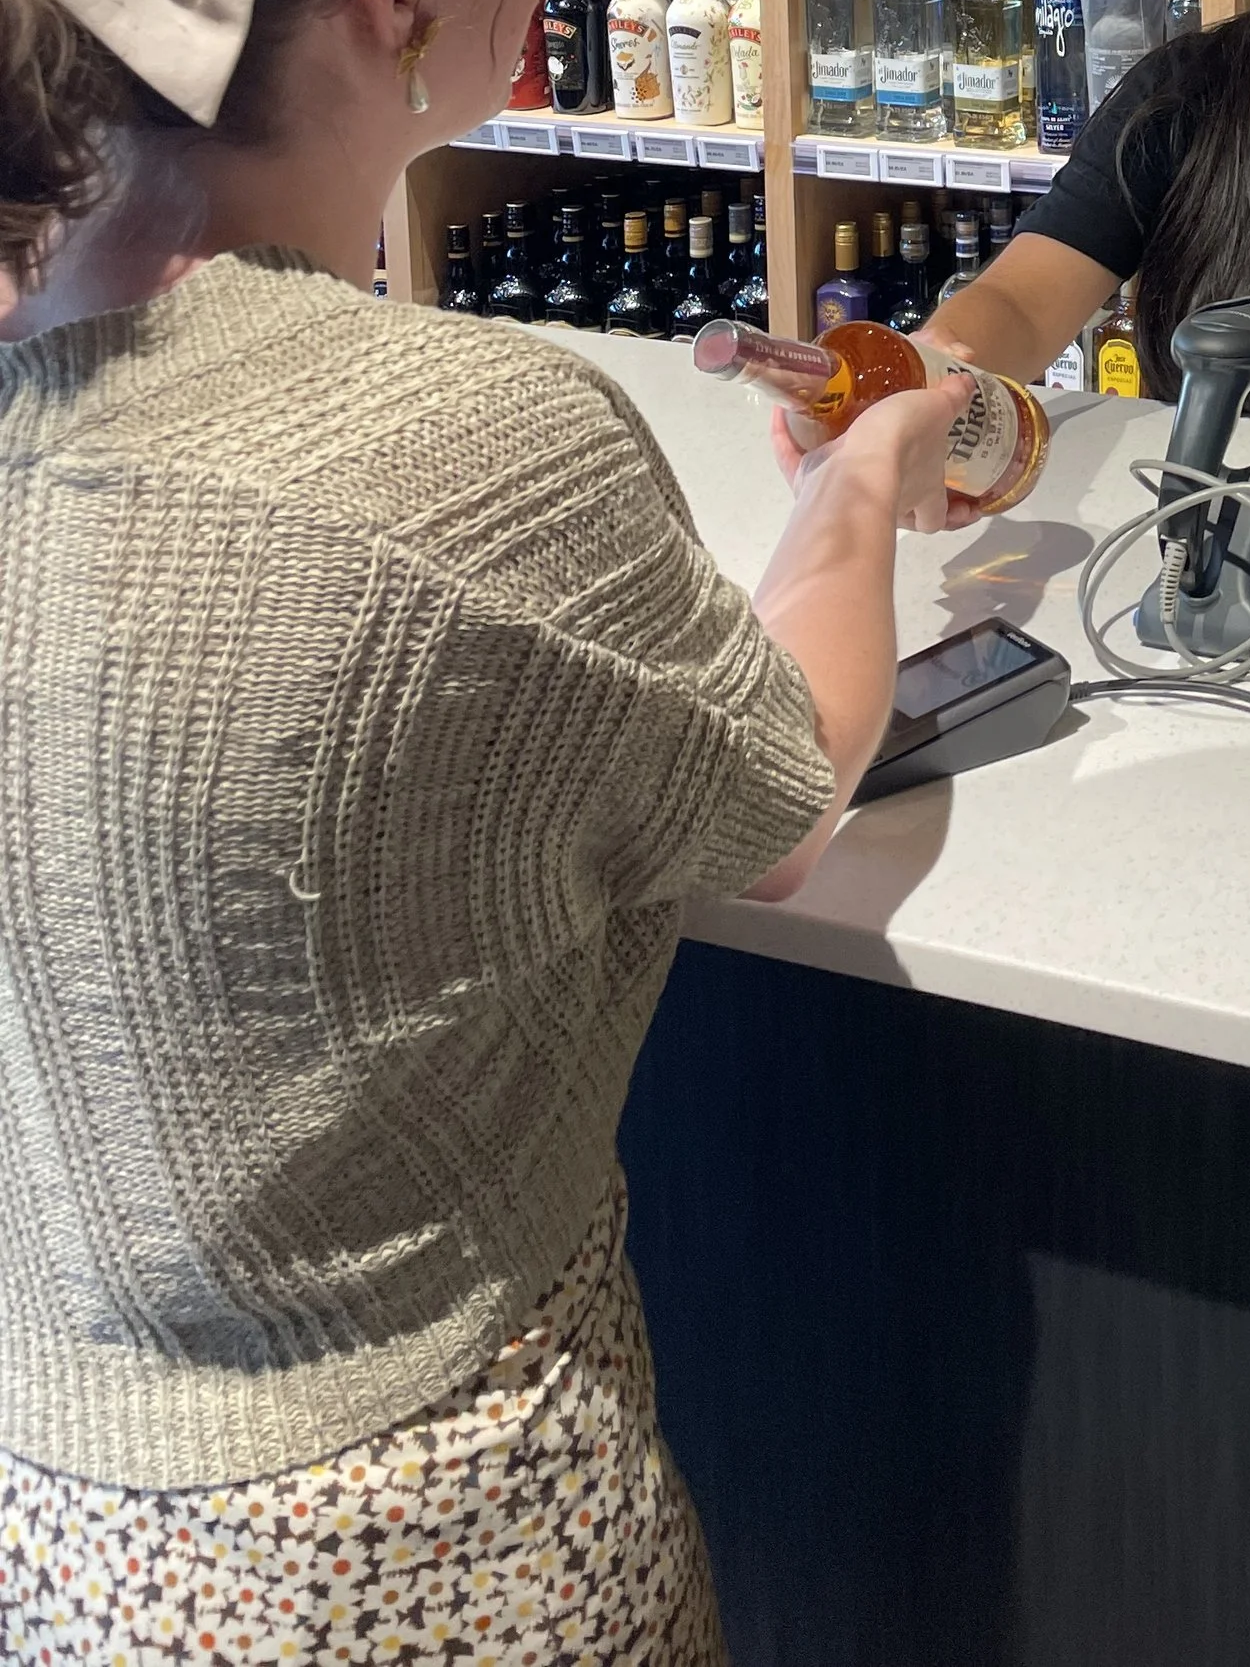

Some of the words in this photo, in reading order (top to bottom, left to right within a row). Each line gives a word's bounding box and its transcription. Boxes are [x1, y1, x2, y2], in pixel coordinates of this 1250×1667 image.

[543, 21, 574, 36] ILEYS
[812, 62, 850, 78] Jimador
[881, 63, 918, 83] Jimador
[960, 70, 997, 90] Jimador
[1104, 358, 1134, 375] Cuervo
